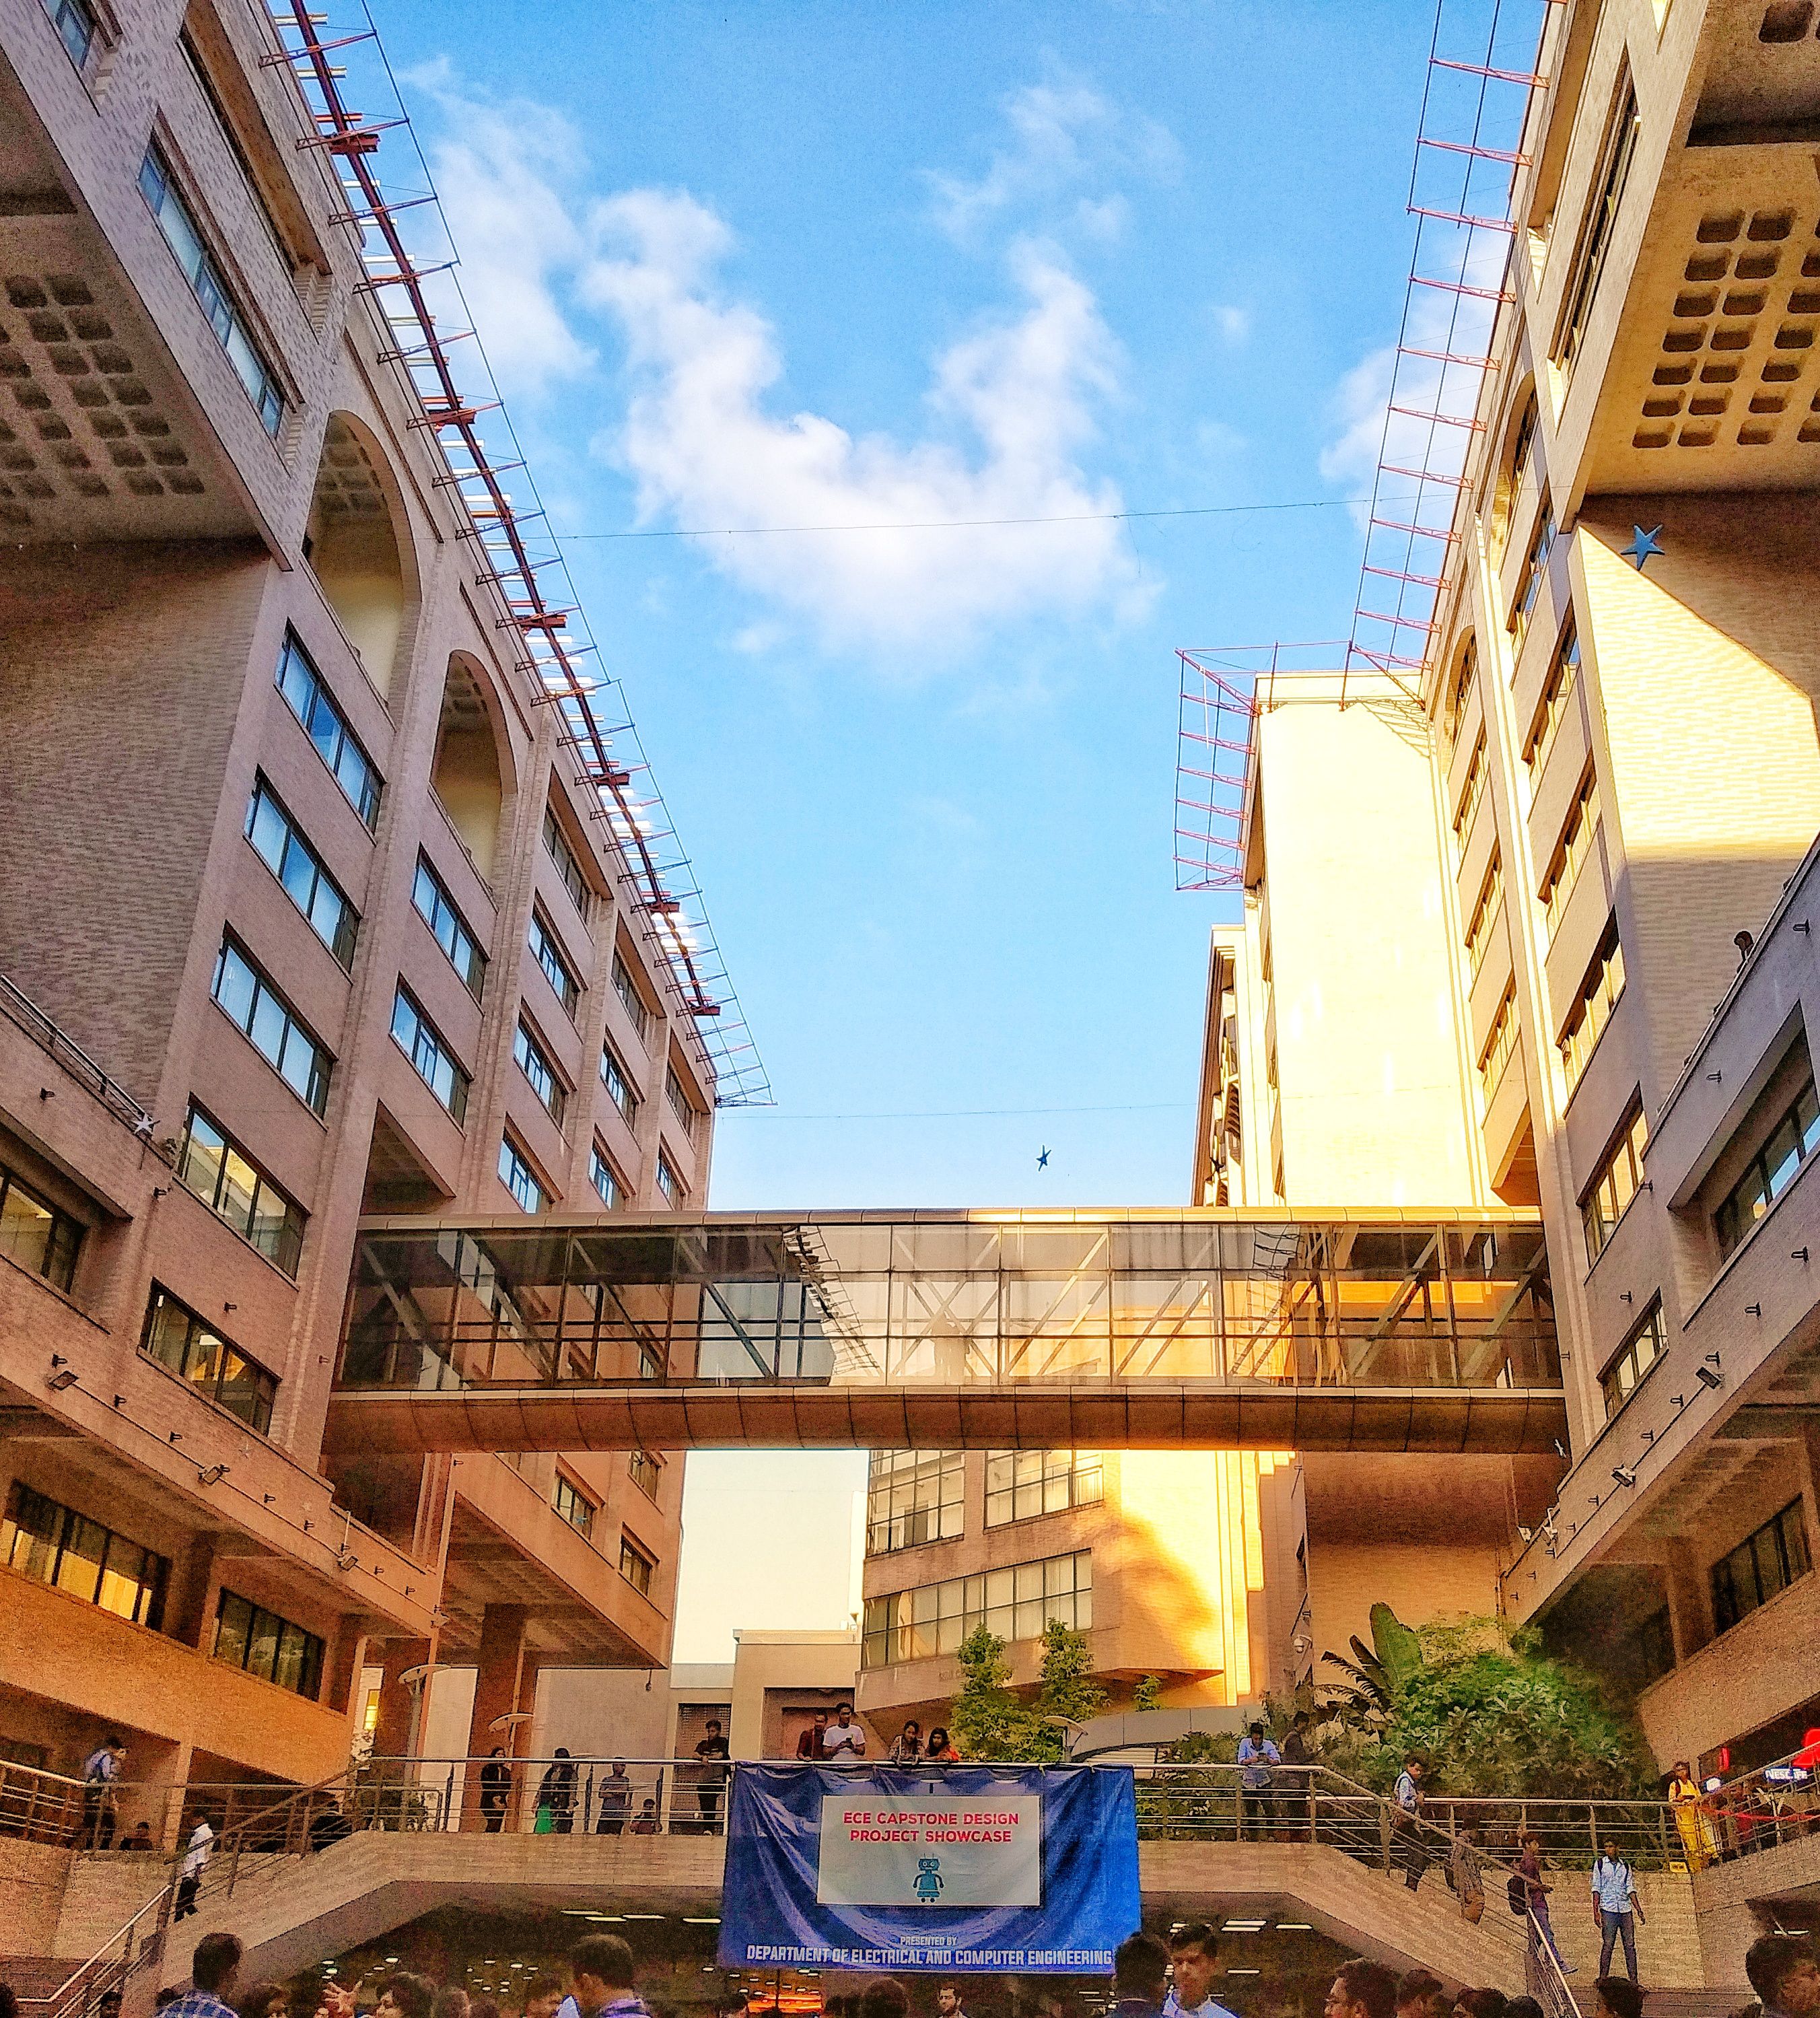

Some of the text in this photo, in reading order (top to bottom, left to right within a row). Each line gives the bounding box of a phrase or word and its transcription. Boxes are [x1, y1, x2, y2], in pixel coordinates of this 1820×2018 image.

[843, 1812, 1019, 1825] ECE CAPSTONE DESIGN
[849, 1830, 1012, 1842] PROJECT SHOWCASE
[900, 1936, 957, 1946] PRESENTED BY
[746, 1945, 1113, 1965] DEPARTMENT OF ELECTRICAL AND COMPUTER ENGINEERING
